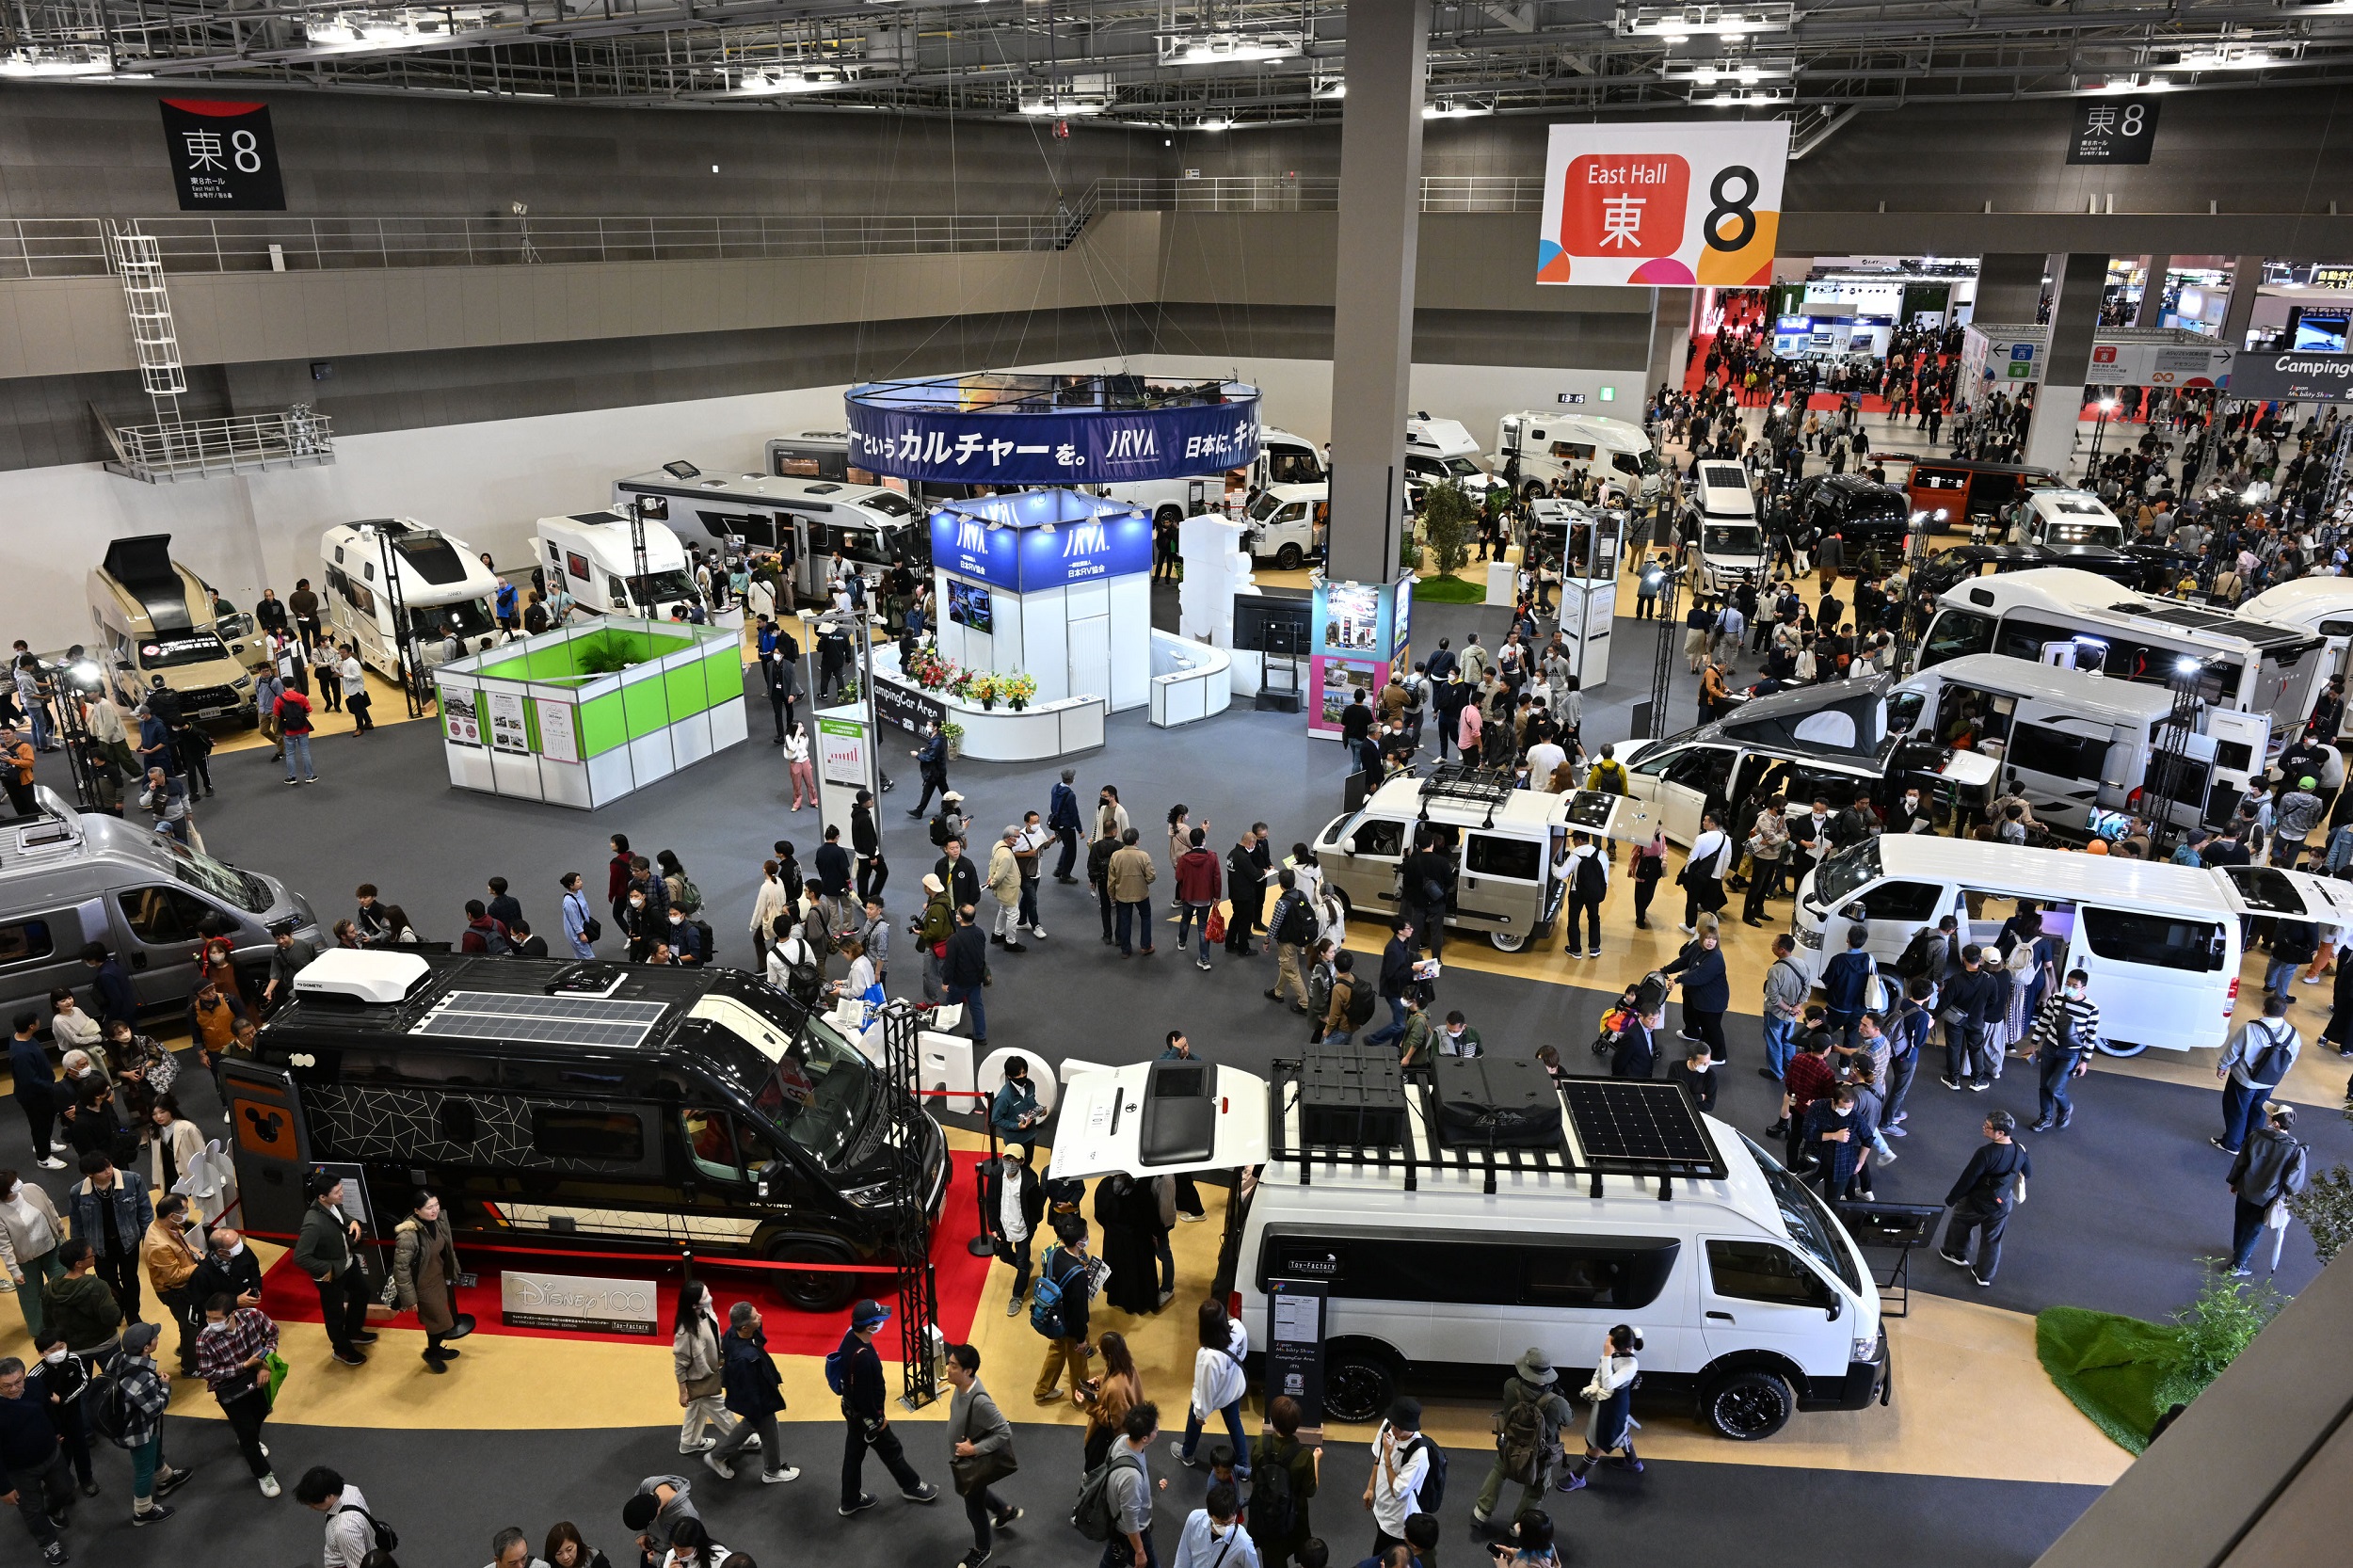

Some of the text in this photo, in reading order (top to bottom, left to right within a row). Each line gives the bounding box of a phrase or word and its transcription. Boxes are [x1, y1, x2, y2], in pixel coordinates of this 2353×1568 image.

[2084, 104, 2145, 136] 東 8
[182, 128, 262, 173] 東 8
[189, 177, 226, 185] 東8ホール
[1588, 163, 1668, 184] East Hall
[1703, 165, 1760, 252] 8
[1598, 192, 1647, 249] 東
[2275, 356, 2353, 377] Camping
[1561, 394, 1585, 403] 13:15
[1067, 565, 1105, 578] 日本RV協会
[874, 684, 916, 710] ampingCar
[1290, 1261, 1336, 1271] Toy-Factory
[600, 1290, 648, 1313] 100
